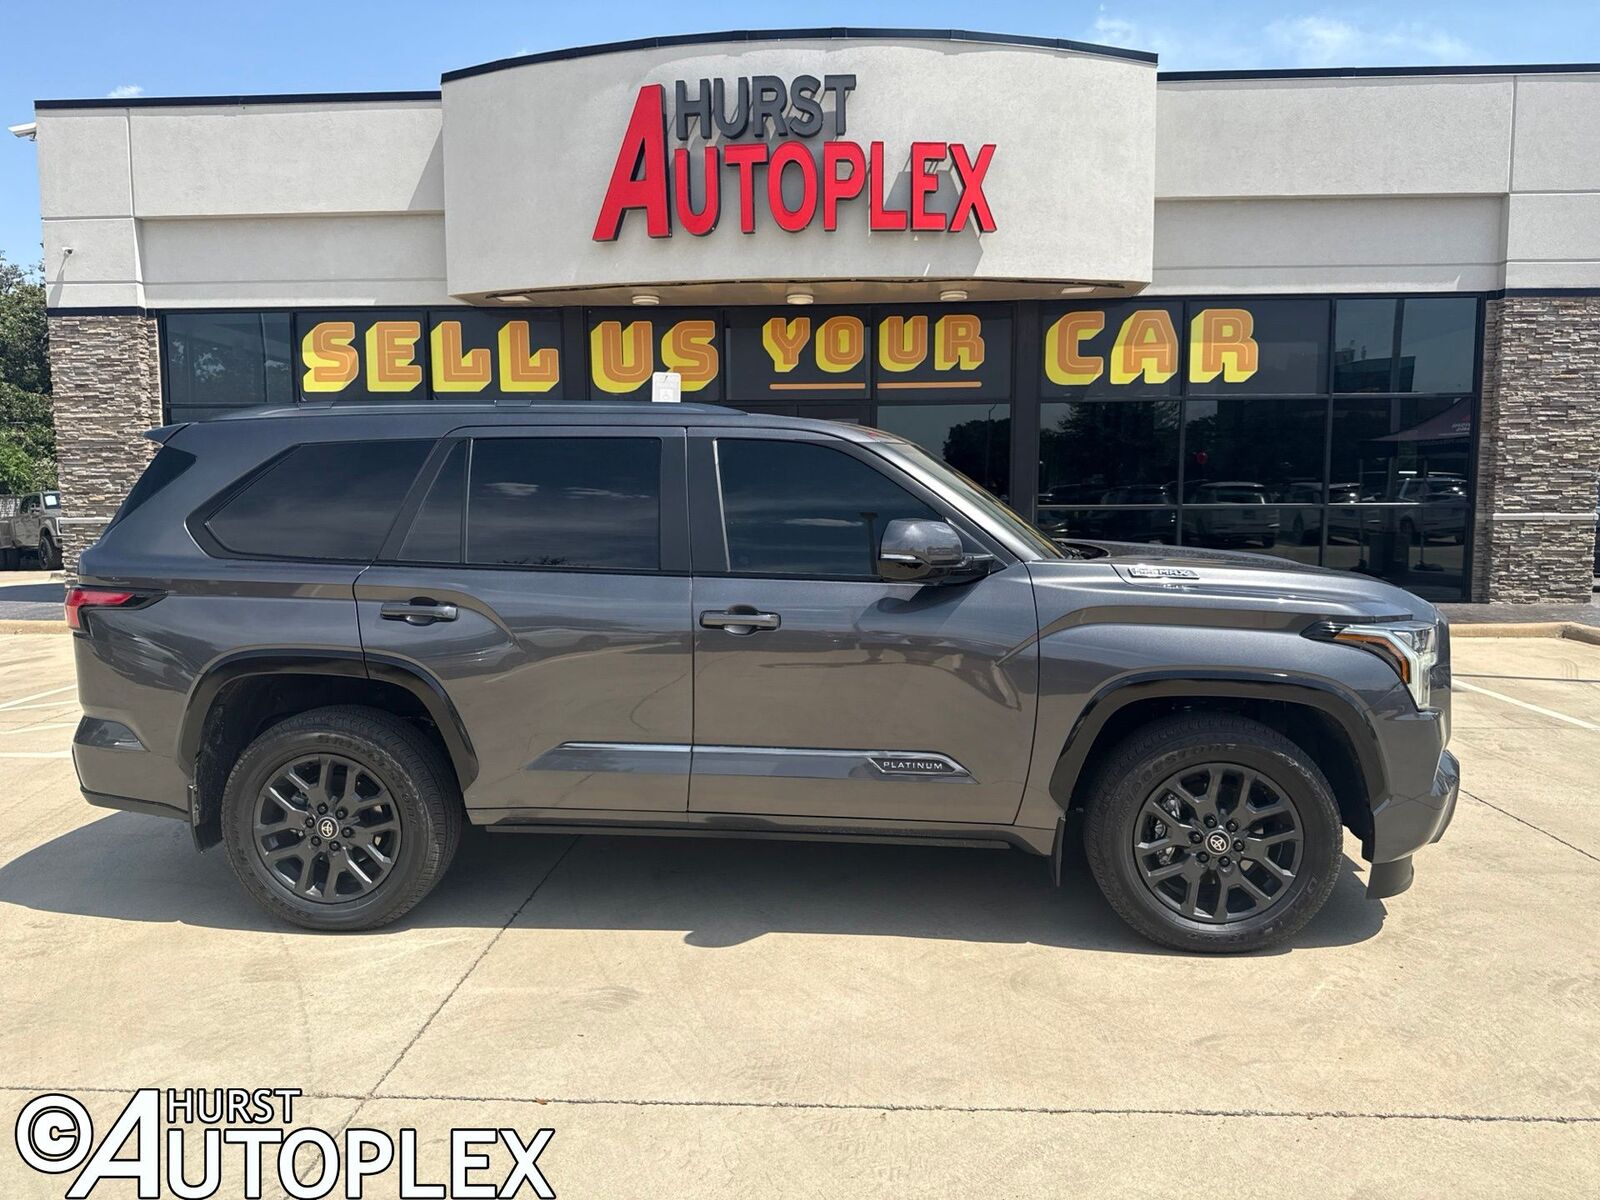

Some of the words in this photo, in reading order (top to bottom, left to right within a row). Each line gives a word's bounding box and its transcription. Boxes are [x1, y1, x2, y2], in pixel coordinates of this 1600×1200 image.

[674, 74, 857, 141] HURST
[592, 84, 998, 242] AUTOPLEX
[301, 320, 561, 393] SELL
[591, 320, 720, 393] US
[762, 315, 985, 373] YOUR
[1045, 308, 1259, 386] CAR
[882, 761, 943, 770] PLATINUM
